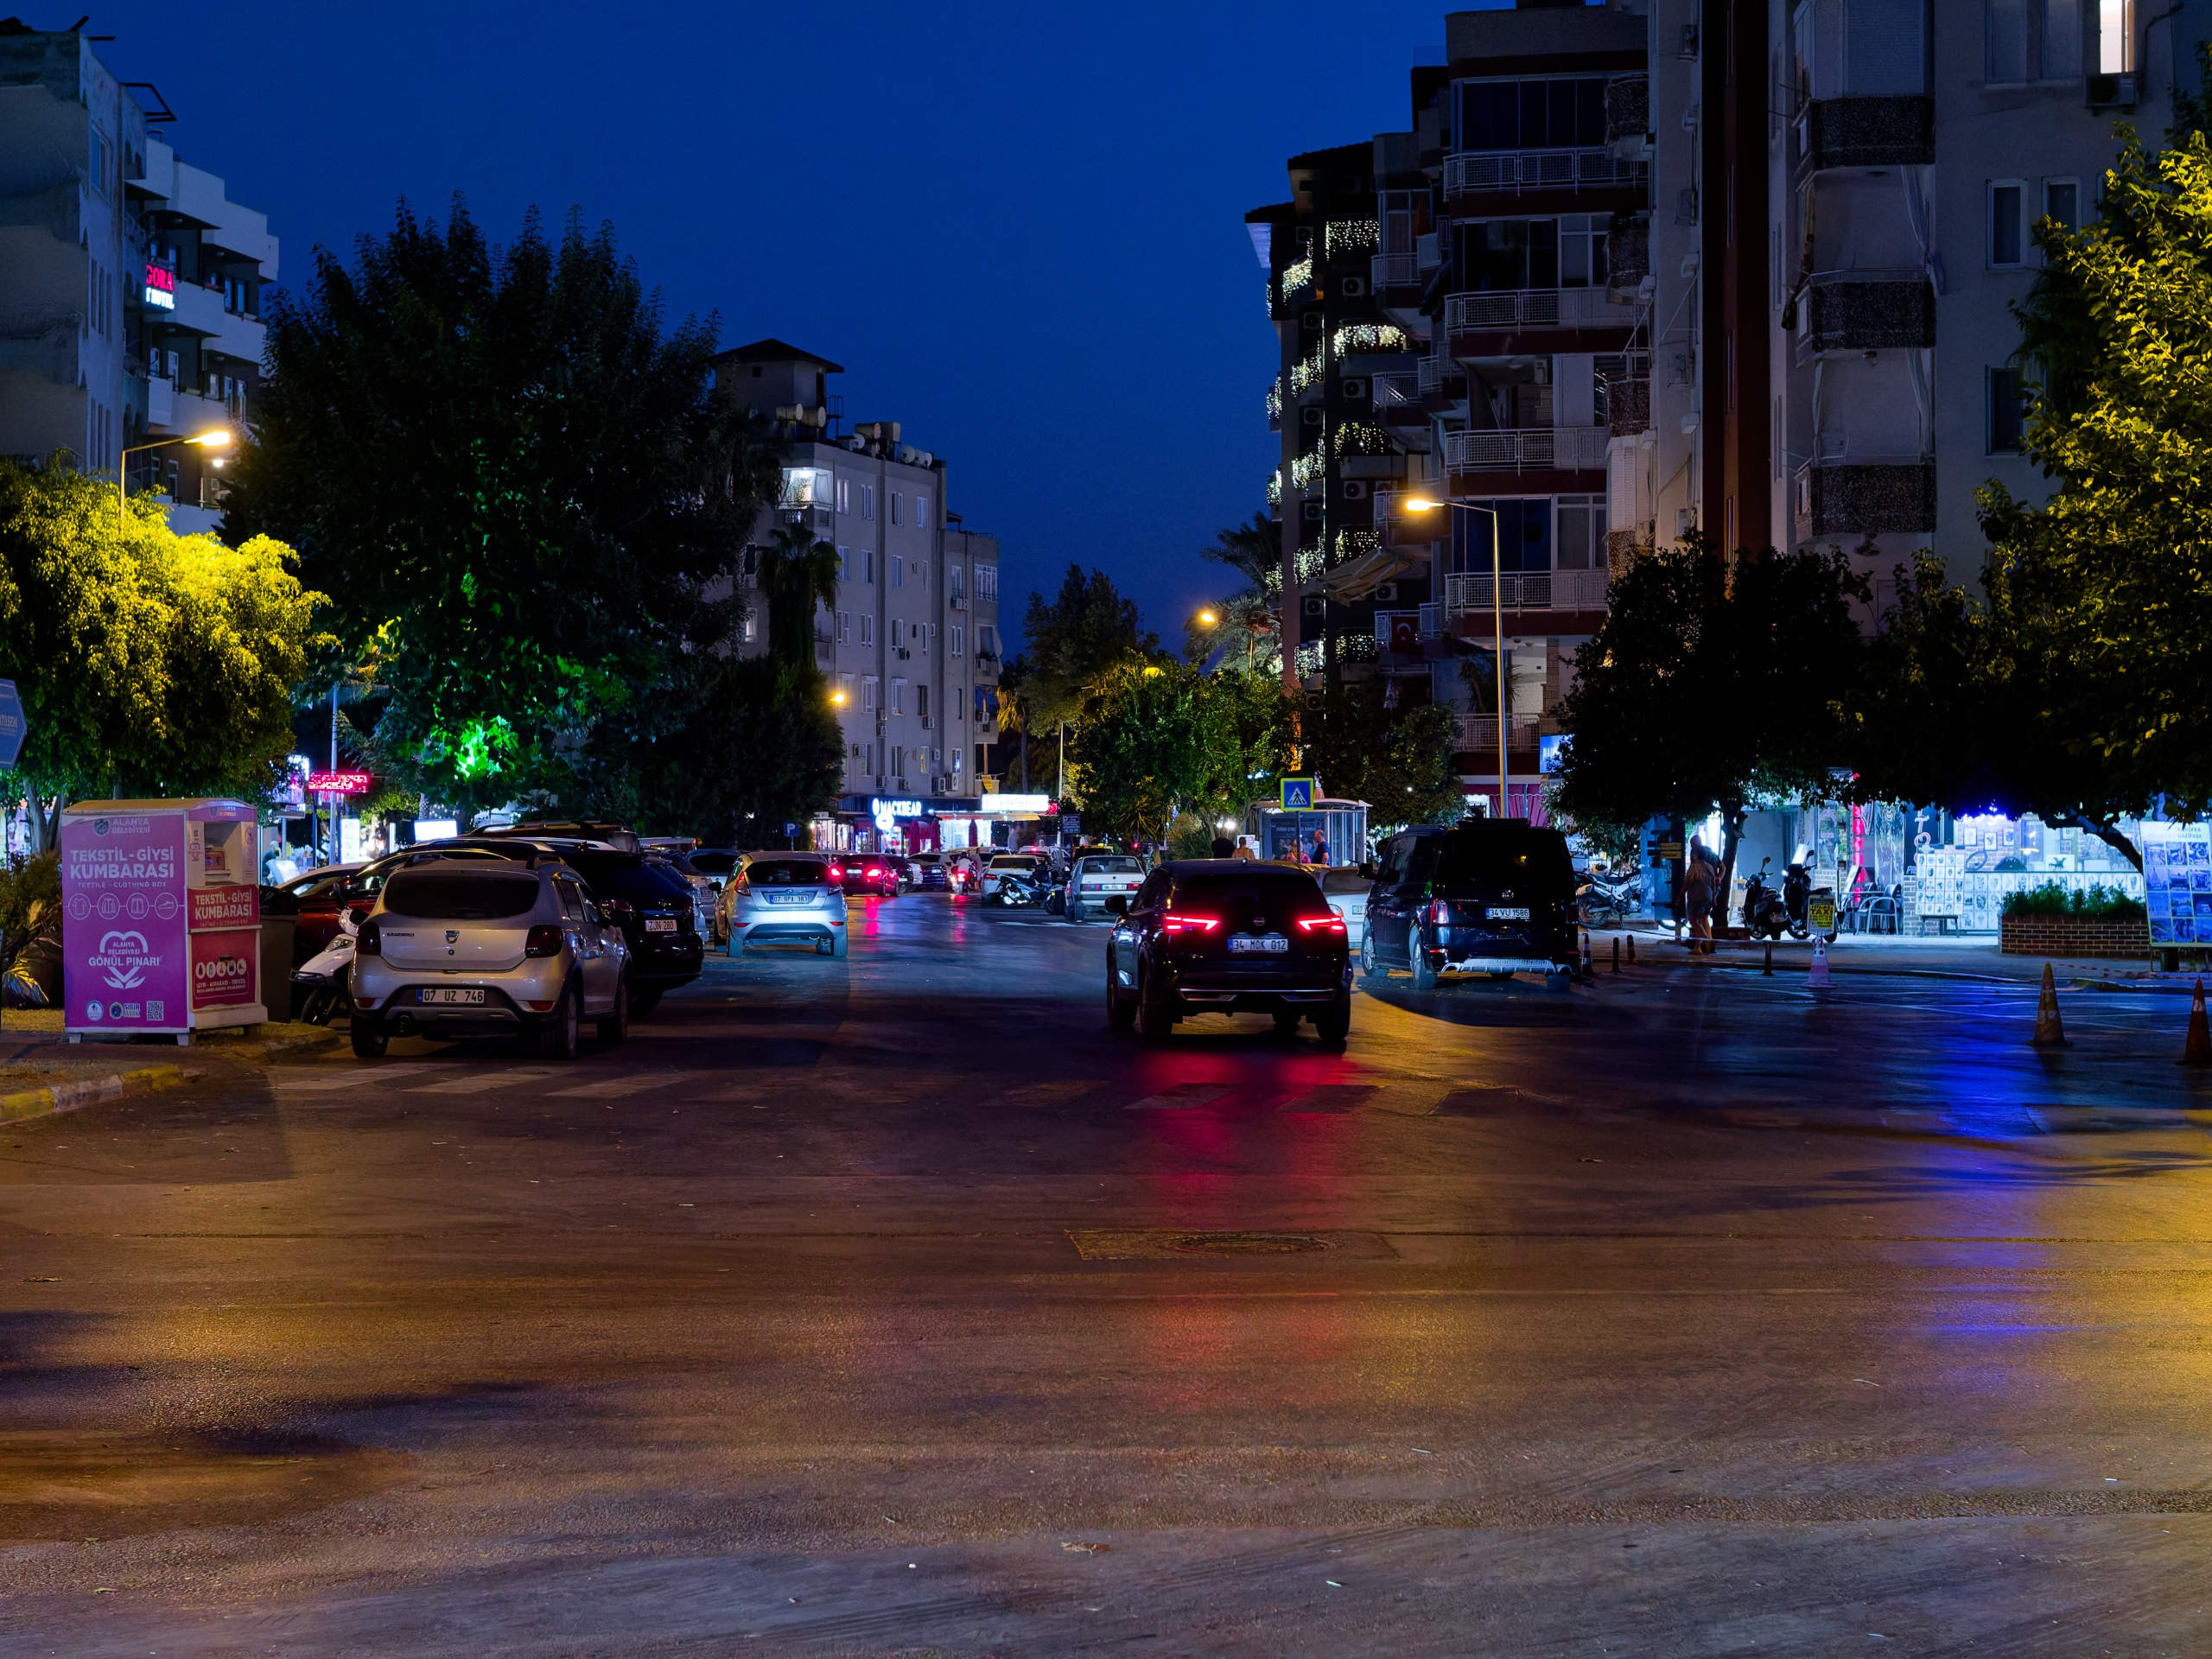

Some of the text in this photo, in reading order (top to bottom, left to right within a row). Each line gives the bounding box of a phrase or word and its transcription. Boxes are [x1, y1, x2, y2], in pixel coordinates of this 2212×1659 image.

[880, 800, 922, 817] MACKBEAR
[112, 817, 149, 826] ALANYA
[70, 847, 128, 862] TEKSTİL
[137, 846, 174, 861] GİYSİ
[70, 863, 175, 880] KUMBARASI
[195, 891, 227, 906] TEKSTİL
[232, 888, 252, 903] GİYSİ
[195, 904, 252, 920] KUMBARASI
[1233, 939, 1245, 950] 34
[1271, 939, 1287, 950] 012
[88, 955, 160, 966] GÖNÜL PINARI
[424, 990, 484, 1001] 07 UZ 746
